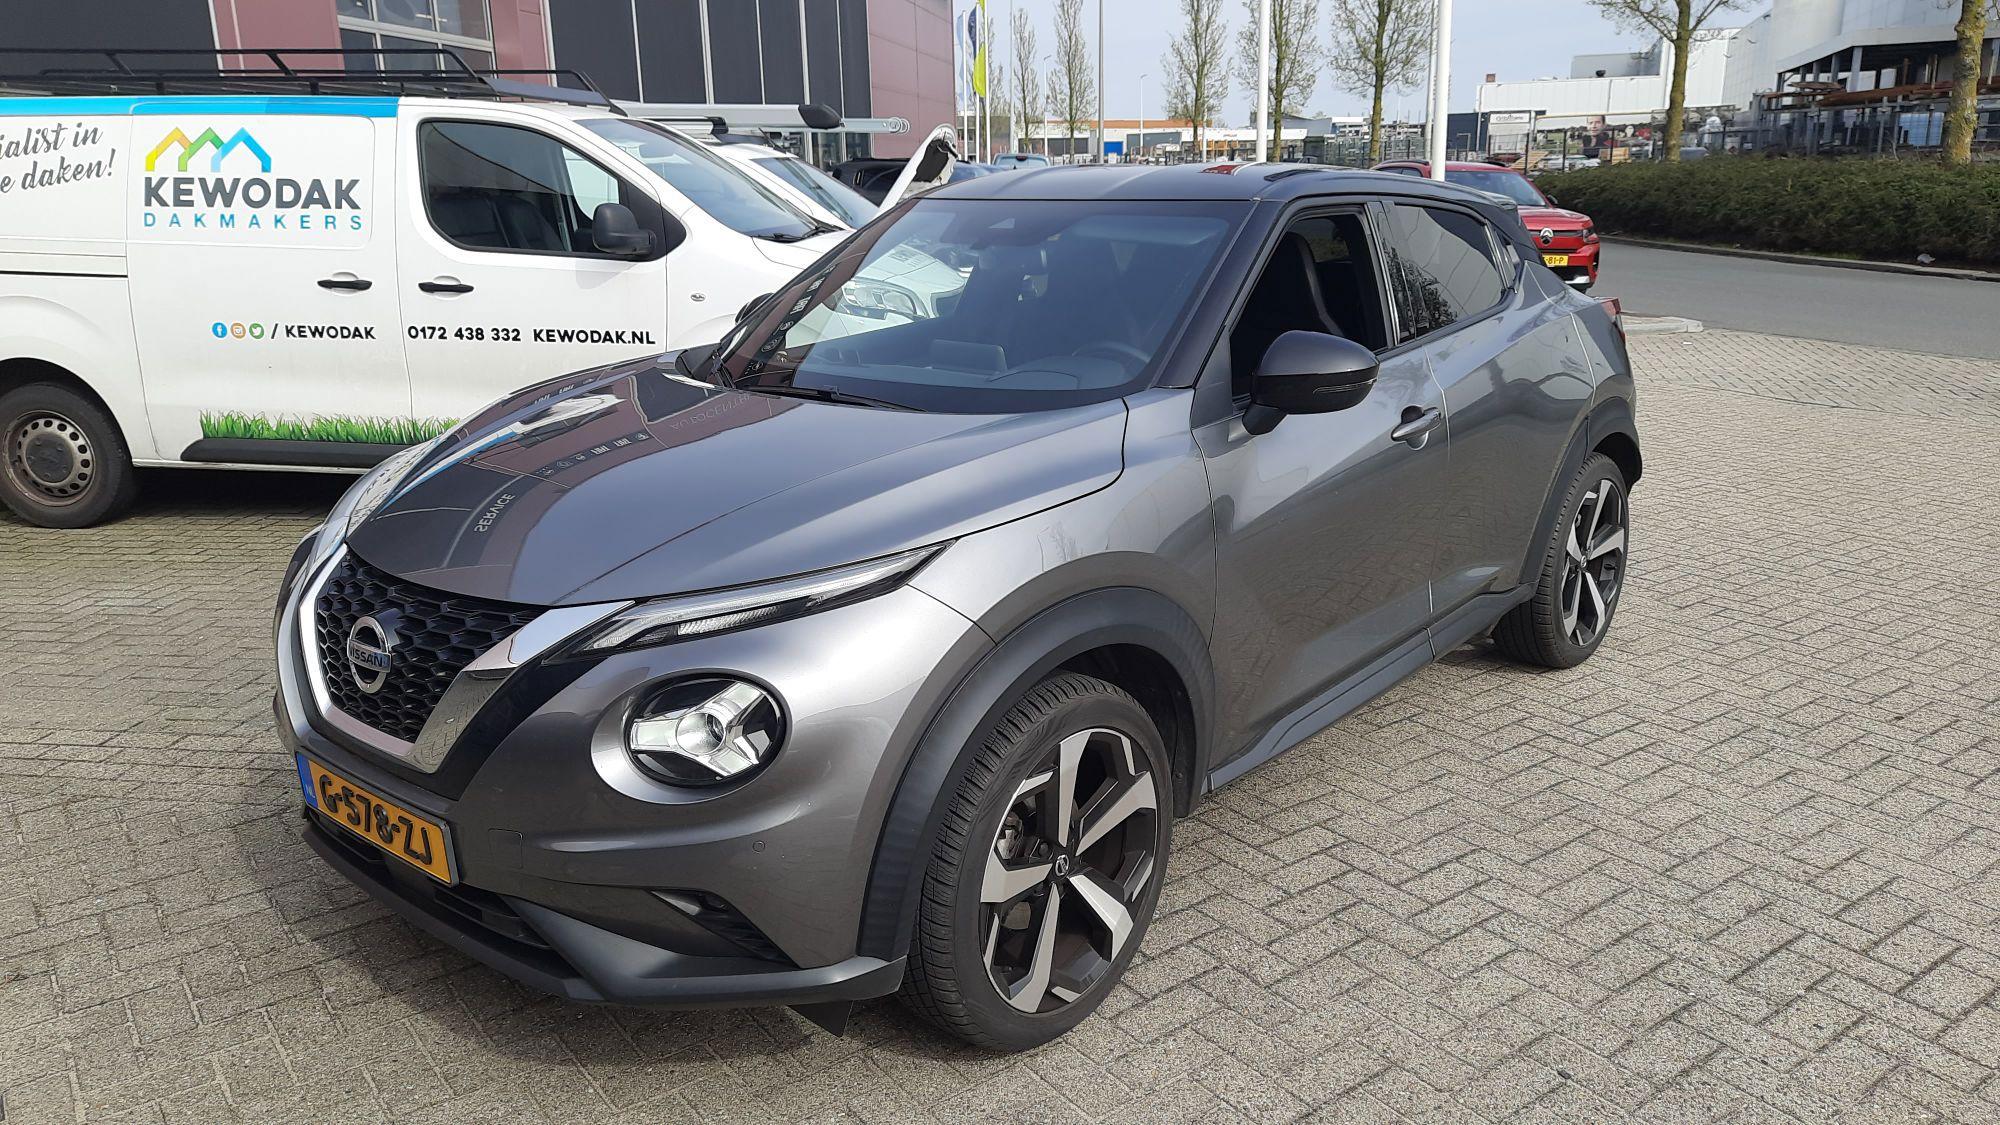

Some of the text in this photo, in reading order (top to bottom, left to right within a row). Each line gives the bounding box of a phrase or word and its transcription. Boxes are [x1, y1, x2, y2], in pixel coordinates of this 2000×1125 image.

[72, 122, 104, 148] in
[21, 148, 116, 190] daken!
[144, 176, 362, 210] KEWODAK
[144, 212, 362, 231] DAKMAKERS
[1543, 256, 1564, 265] -81-P
[285, 324, 377, 340] KEWODAK
[407, 325, 656, 345] 0172 438 332 KEWODAK.NL
[350, 646, 383, 667] NISSAN
[319, 774, 432, 865] G-578-ZJ
